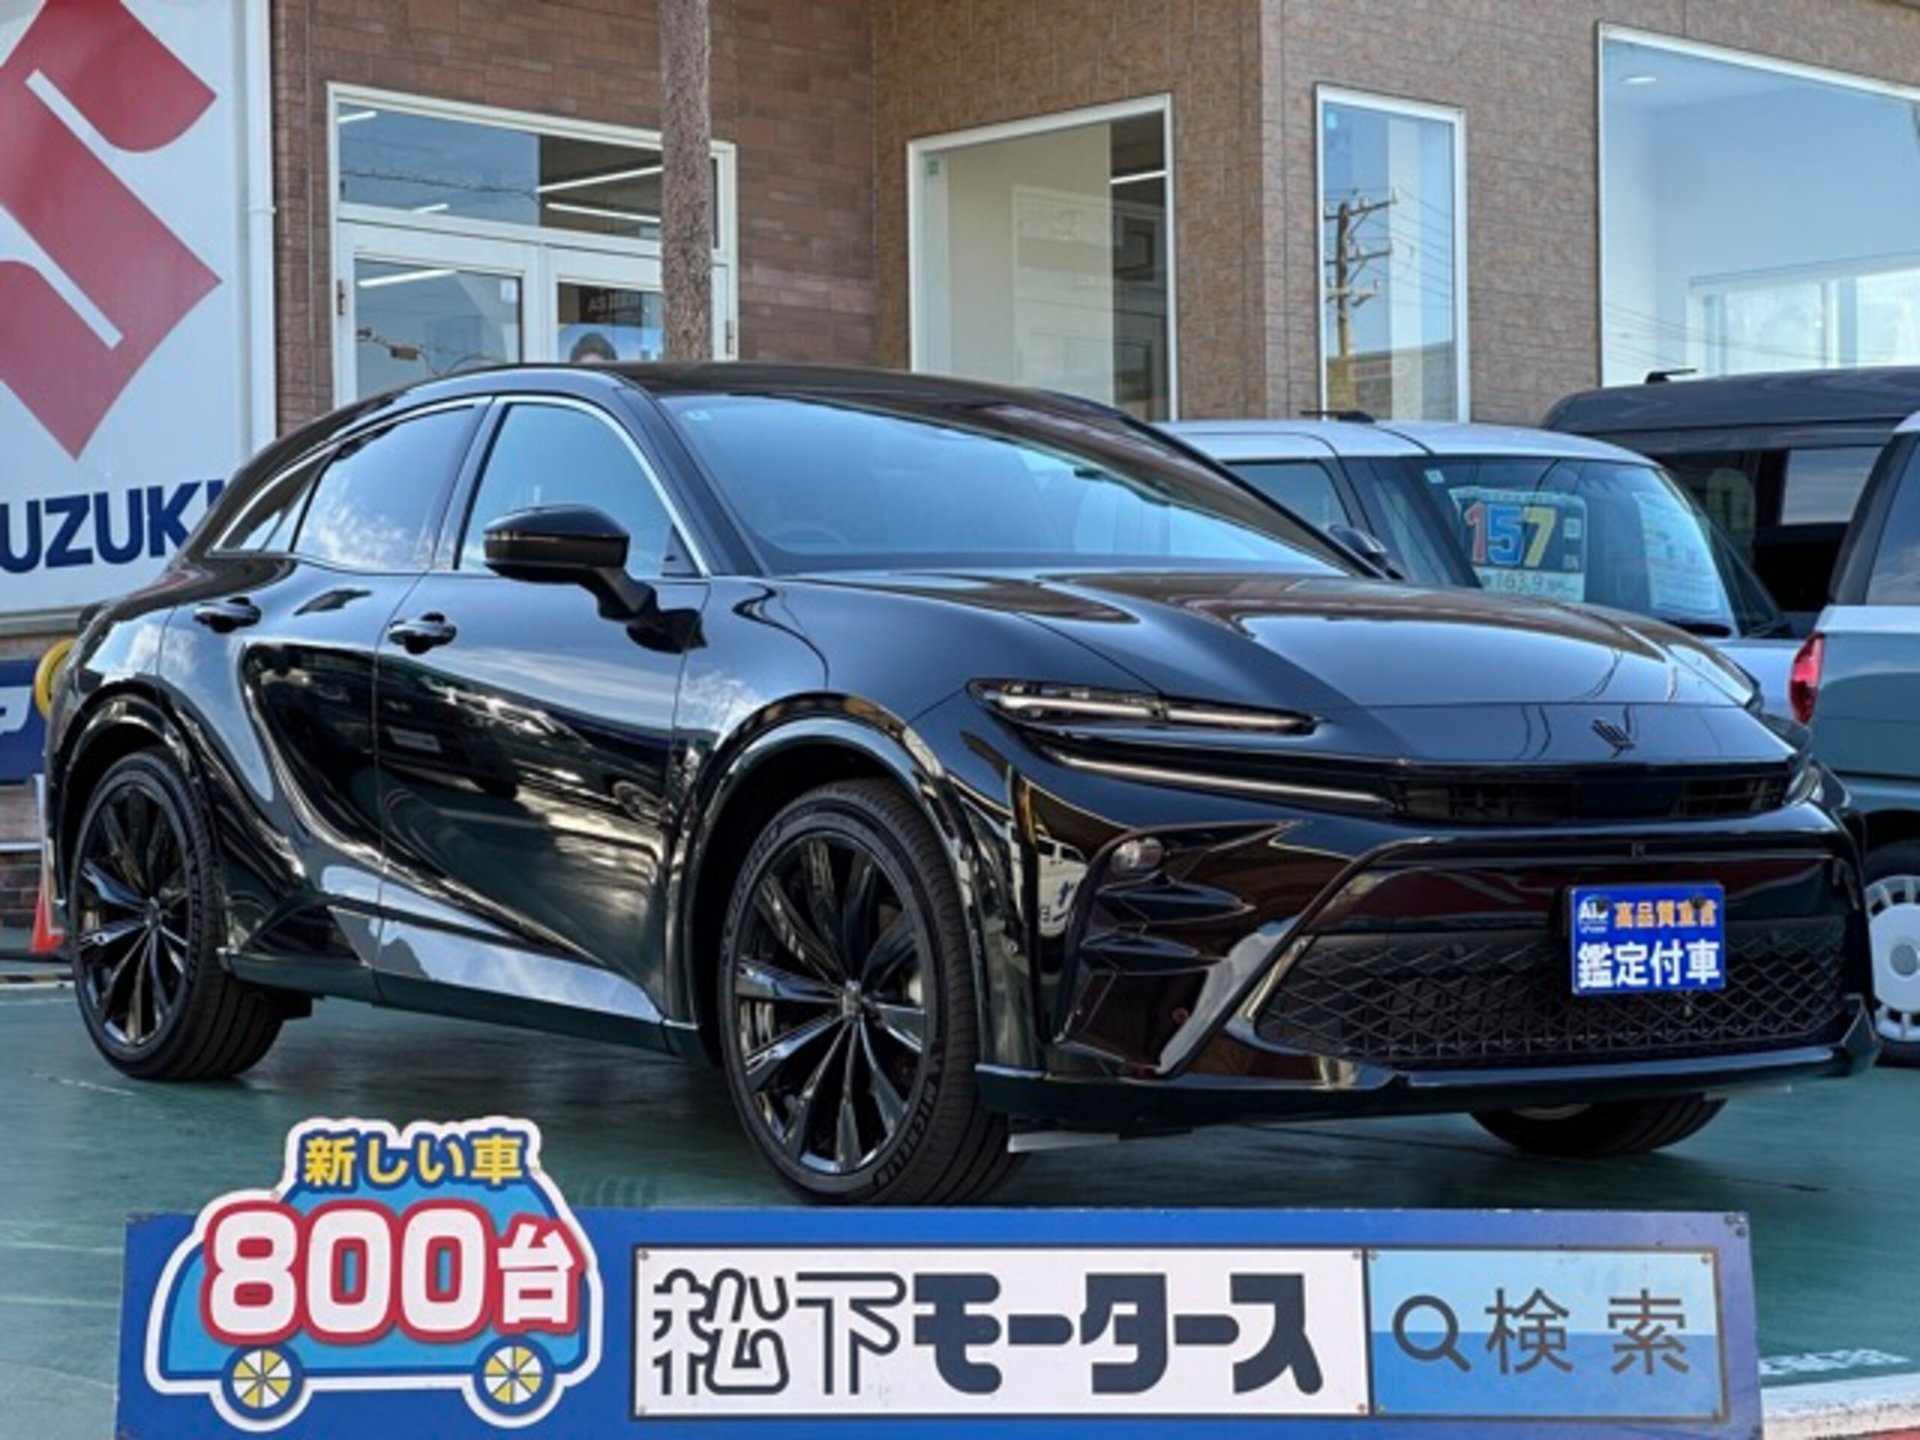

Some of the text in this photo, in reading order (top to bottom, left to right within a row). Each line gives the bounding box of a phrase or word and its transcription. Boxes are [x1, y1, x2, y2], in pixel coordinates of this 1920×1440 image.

[1464, 501, 1556, 567] 157
[1577, 938, 1721, 988] 鑑定付車
[304, 1136, 525, 1186] 新しい車
[209, 1208, 575, 1334] 800台
[652, 1268, 1324, 1396] 松下モータース
[1484, 1287, 1690, 1375] 検索
